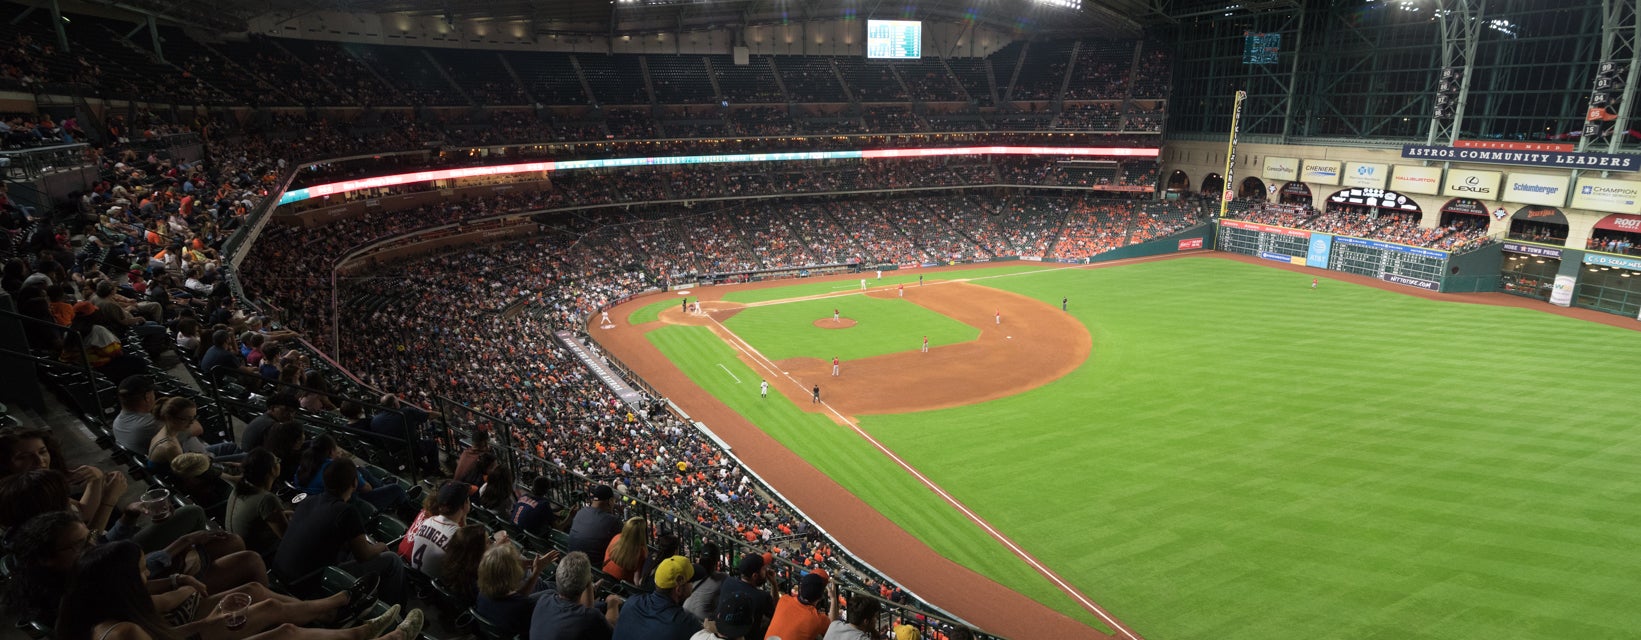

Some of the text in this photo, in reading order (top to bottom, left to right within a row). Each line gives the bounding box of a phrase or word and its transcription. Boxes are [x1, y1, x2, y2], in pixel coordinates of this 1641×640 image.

[1598, 79, 1607, 87] 01
[1590, 110, 1600, 118] 05
[1585, 126, 1595, 134] 15
[1408, 148, 1631, 167] ASTROS COMMUNITY LEADERS
[1451, 184, 1490, 193] LEXUS
[1513, 182, 1559, 195] Schlumberger
[1593, 186, 1637, 195] CHAMPION
[1614, 217, 1641, 226] ROOT
[1527, 247, 1542, 255] TOWN
[412, 543, 428, 567] 4
